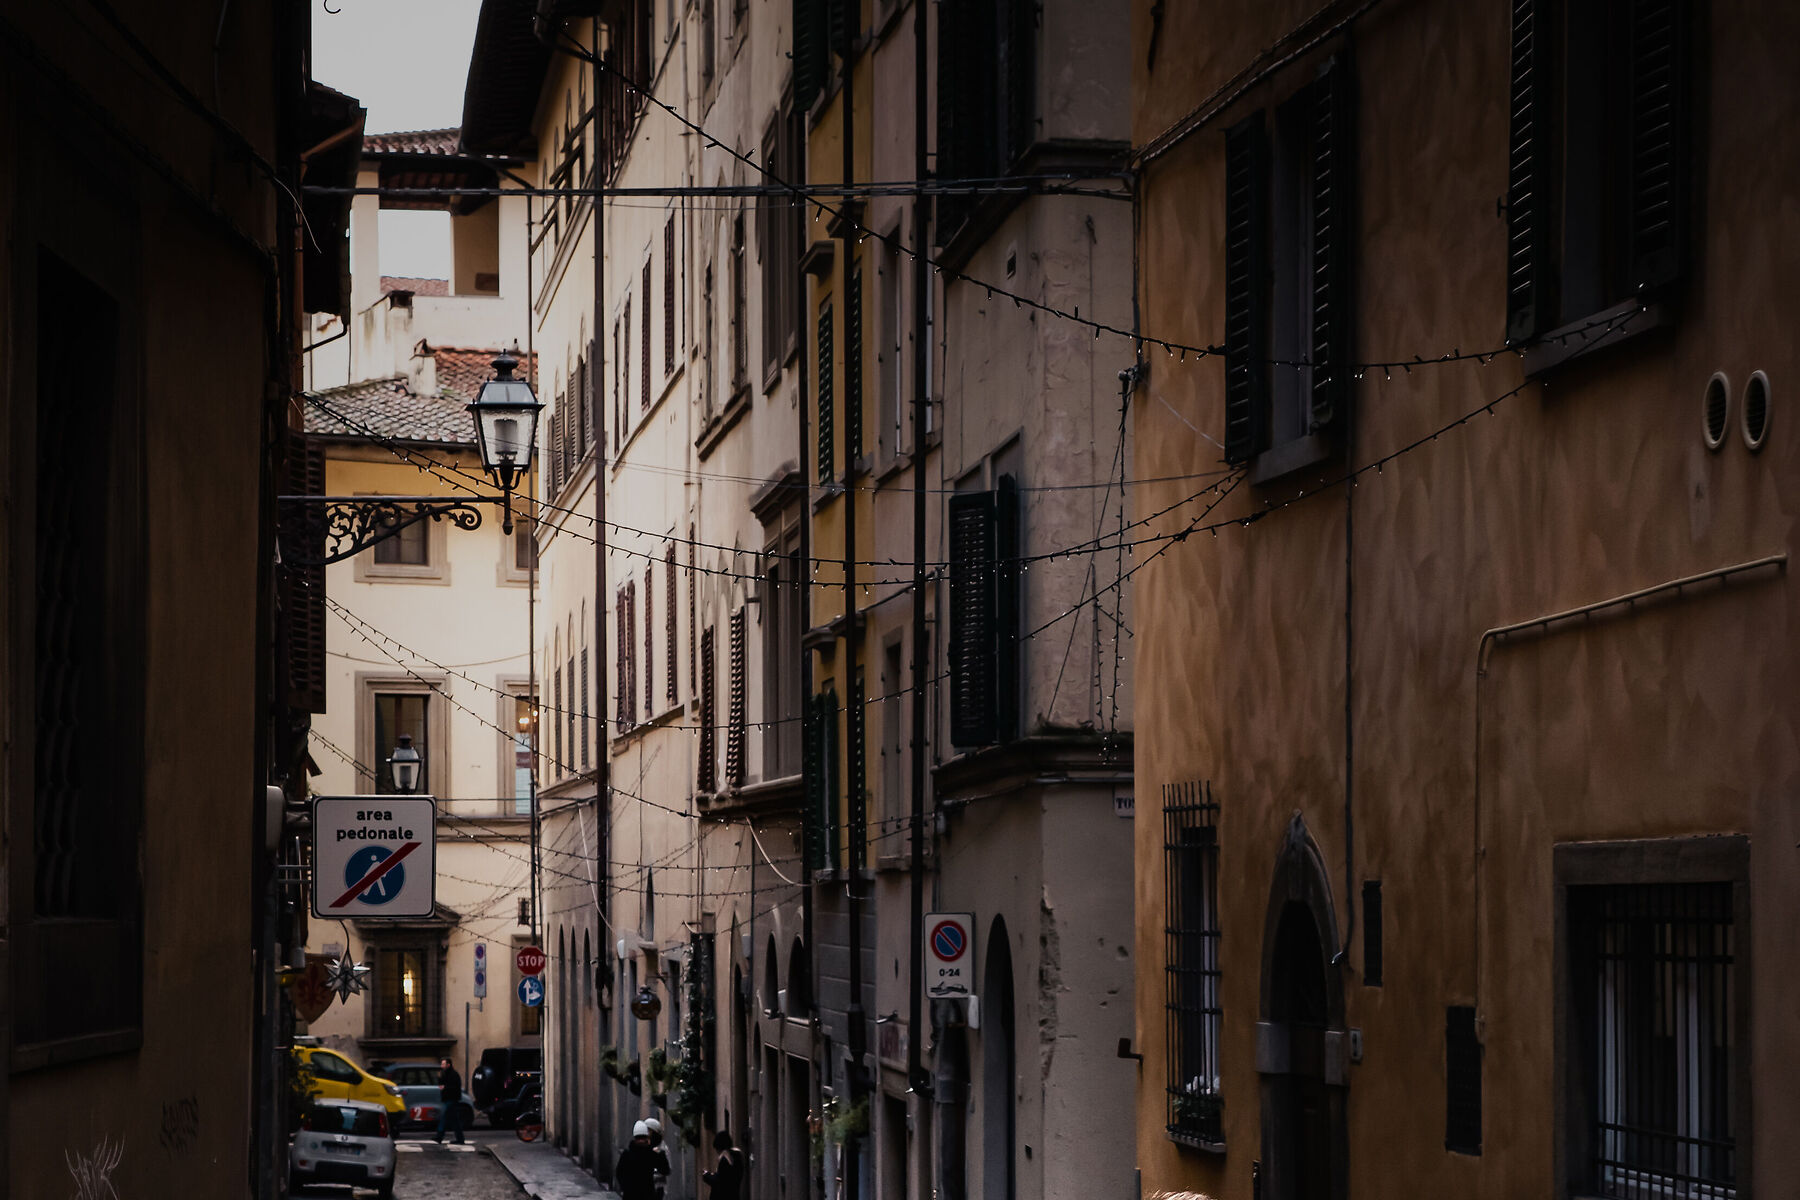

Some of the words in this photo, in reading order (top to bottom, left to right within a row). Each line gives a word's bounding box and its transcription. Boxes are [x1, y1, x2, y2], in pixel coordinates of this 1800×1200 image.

[1116, 797, 1135, 809] TO
[357, 810, 392, 821] area
[336, 826, 413, 841] pedonale
[518, 955, 545, 967] STOP
[939, 968, 960, 977] 0-24
